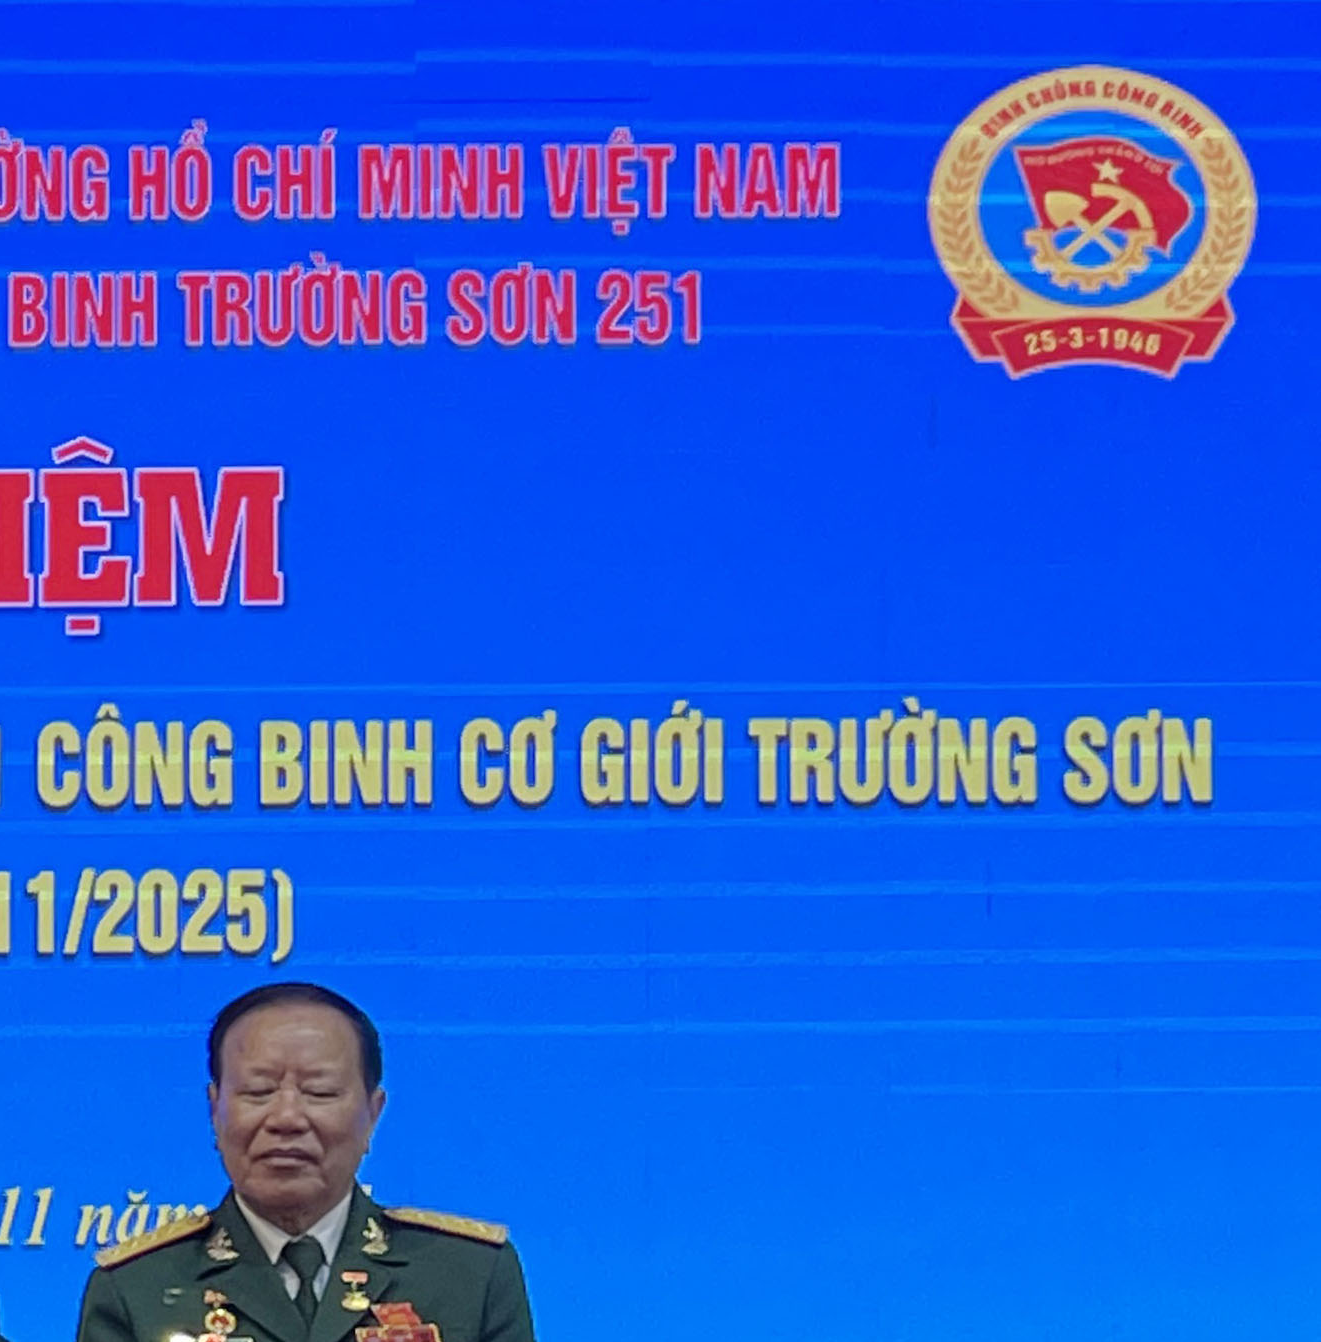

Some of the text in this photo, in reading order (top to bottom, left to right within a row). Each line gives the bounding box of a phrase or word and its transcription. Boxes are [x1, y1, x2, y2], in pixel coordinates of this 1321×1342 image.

[129, 118, 214, 223] HỒ
[233, 127, 337, 222] CHÍ
[358, 143, 525, 220] MINH
[544, 126, 677, 236] VIỆT
[694, 143, 841, 220] NAM
[8, 271, 159, 349] BINH
[177, 251, 428, 348] TRƯỜNG
[446, 261, 577, 347] SƠN
[596, 269, 702, 346] 251
[37, 703, 233, 808] CÔNG
[260, 720, 433, 806] BINH
[460, 709, 556, 805] CƠ
[580, 700, 724, 805] GIỚI
[748, 697, 1038, 805] TRƯỜNG
[1063, 709, 1213, 804] SƠN
